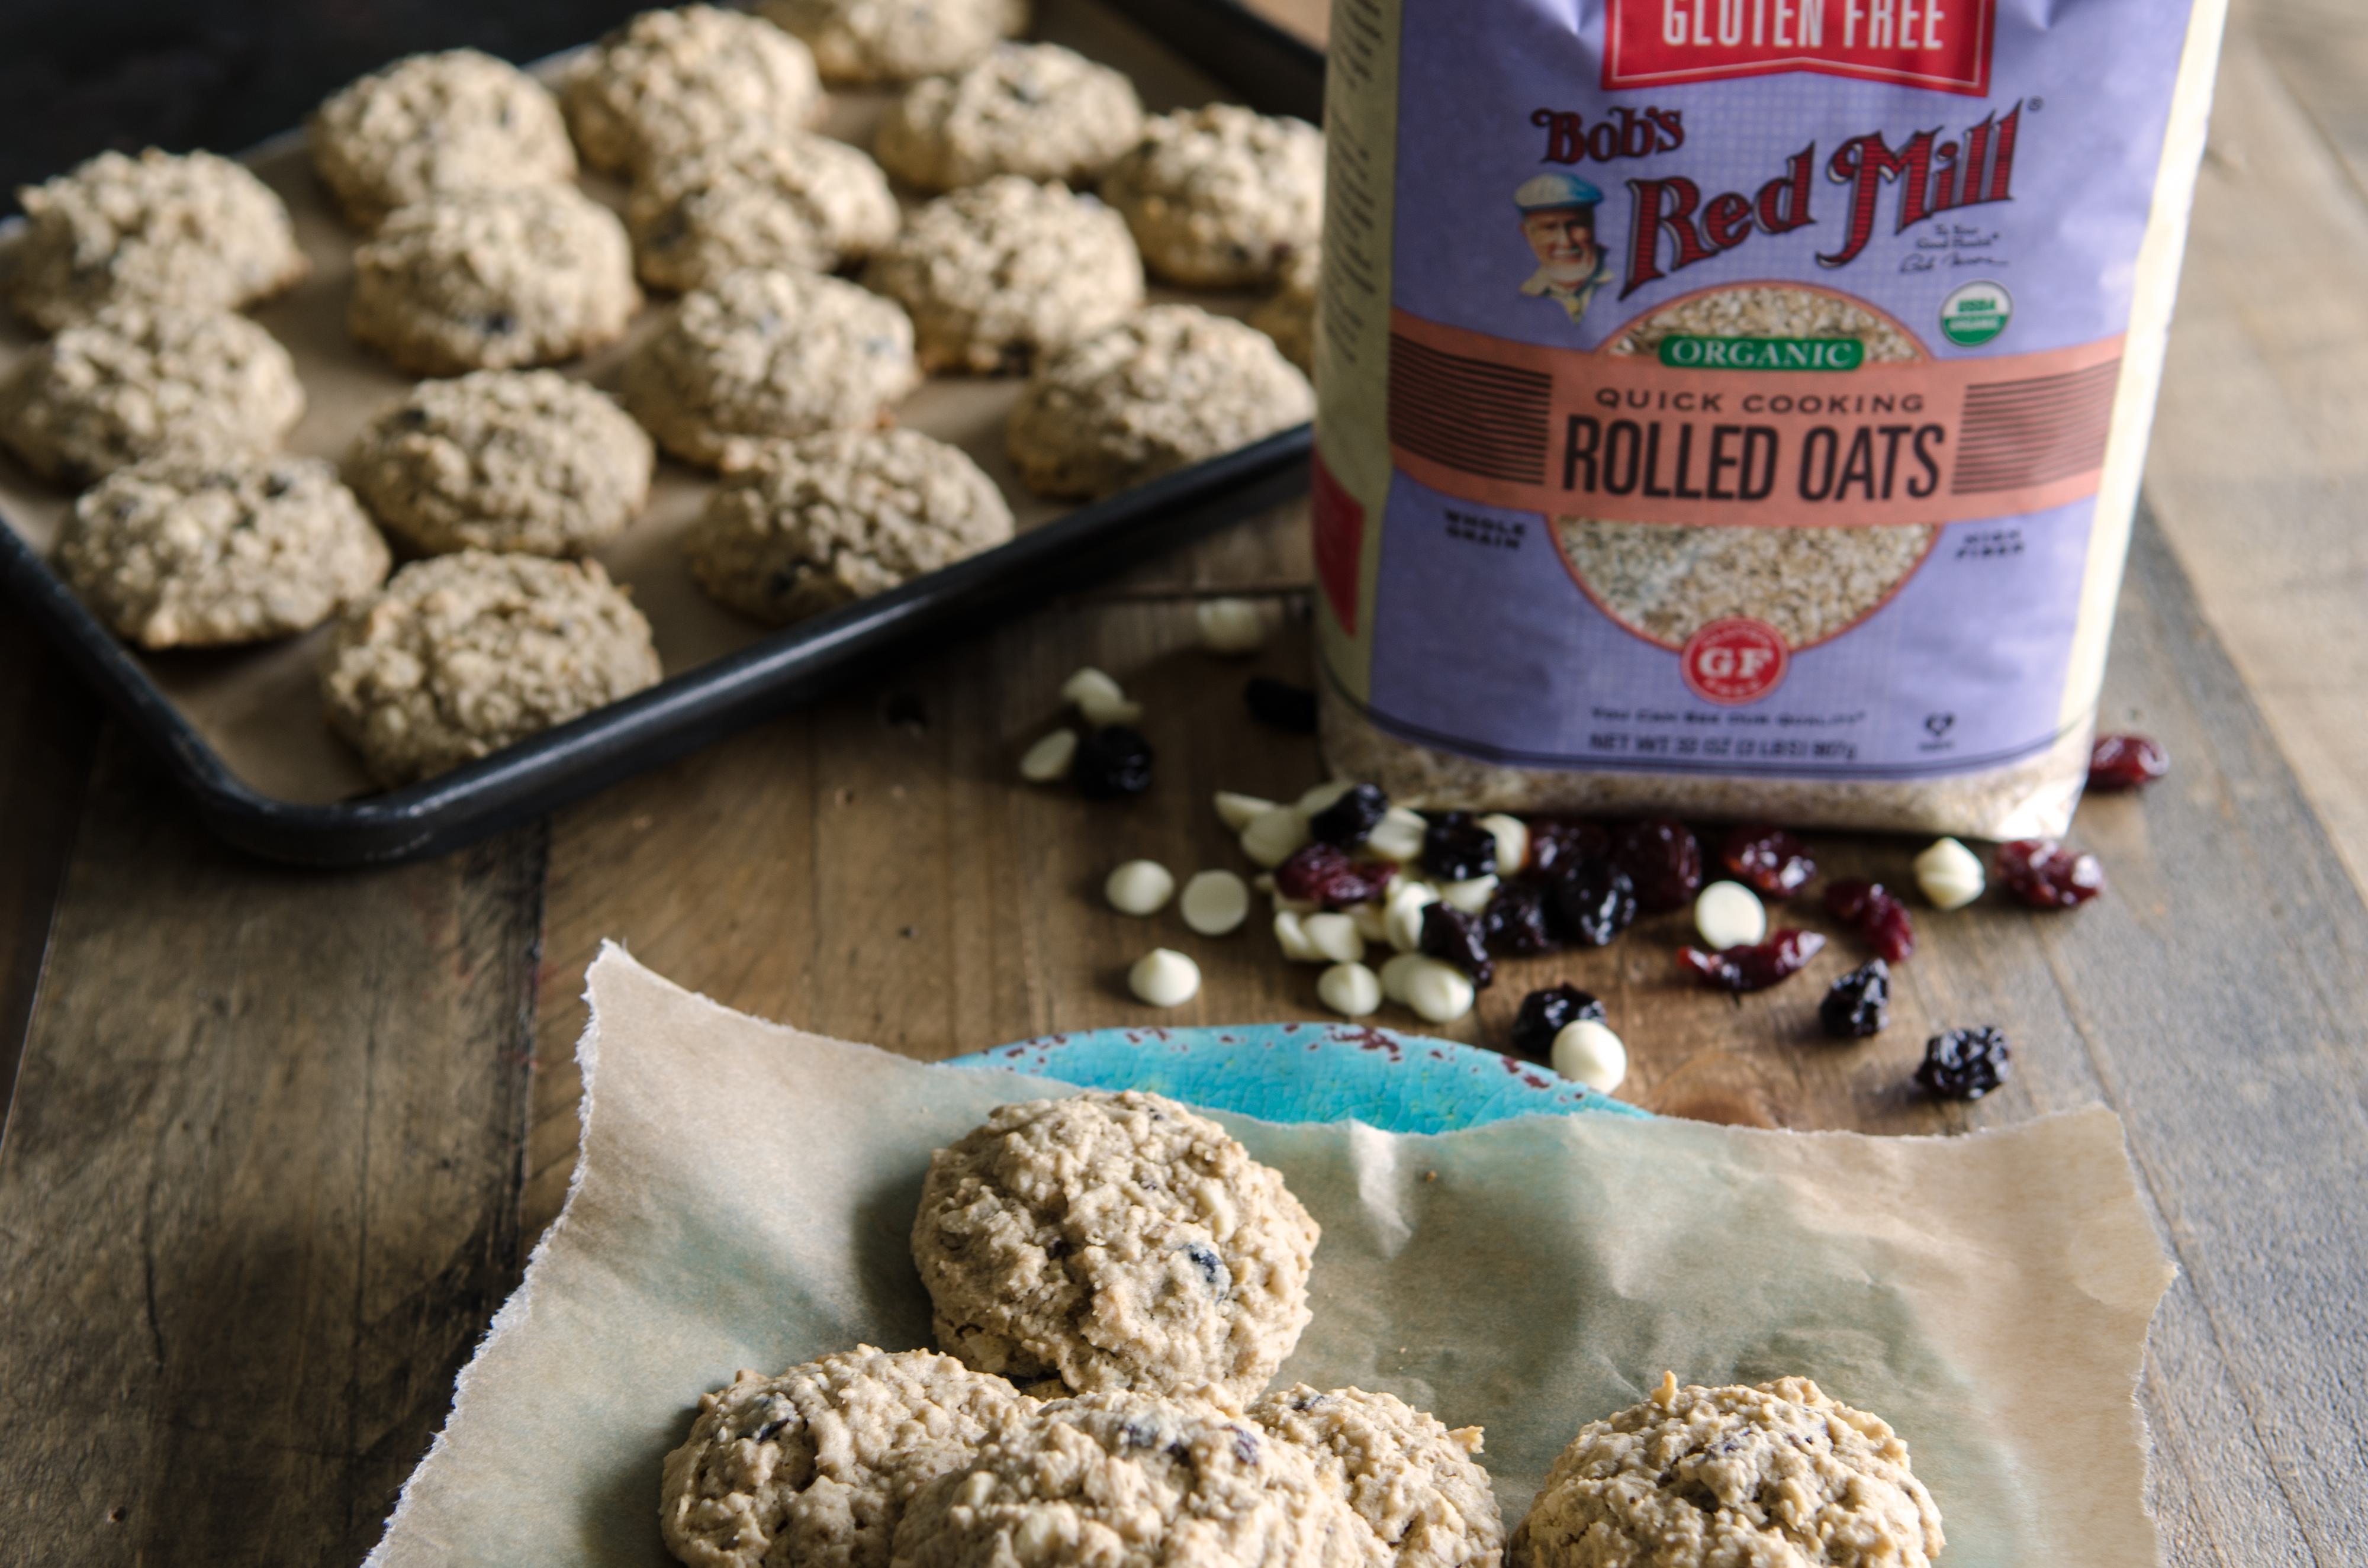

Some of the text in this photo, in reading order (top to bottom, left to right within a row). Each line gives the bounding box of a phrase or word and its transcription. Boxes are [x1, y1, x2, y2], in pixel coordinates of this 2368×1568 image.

[1662, 0, 1945, 49] GLUTEN FREE
[1530, 105, 1685, 165] Bob's
[1617, 97, 2023, 301] Red Mill
[1671, 340, 1854, 368] ORGANIC
[1595, 387, 1925, 414] QUICK COOKING
[1564, 414, 1945, 501] ROLLED OATS
[1698, 646, 1774, 678] GF
